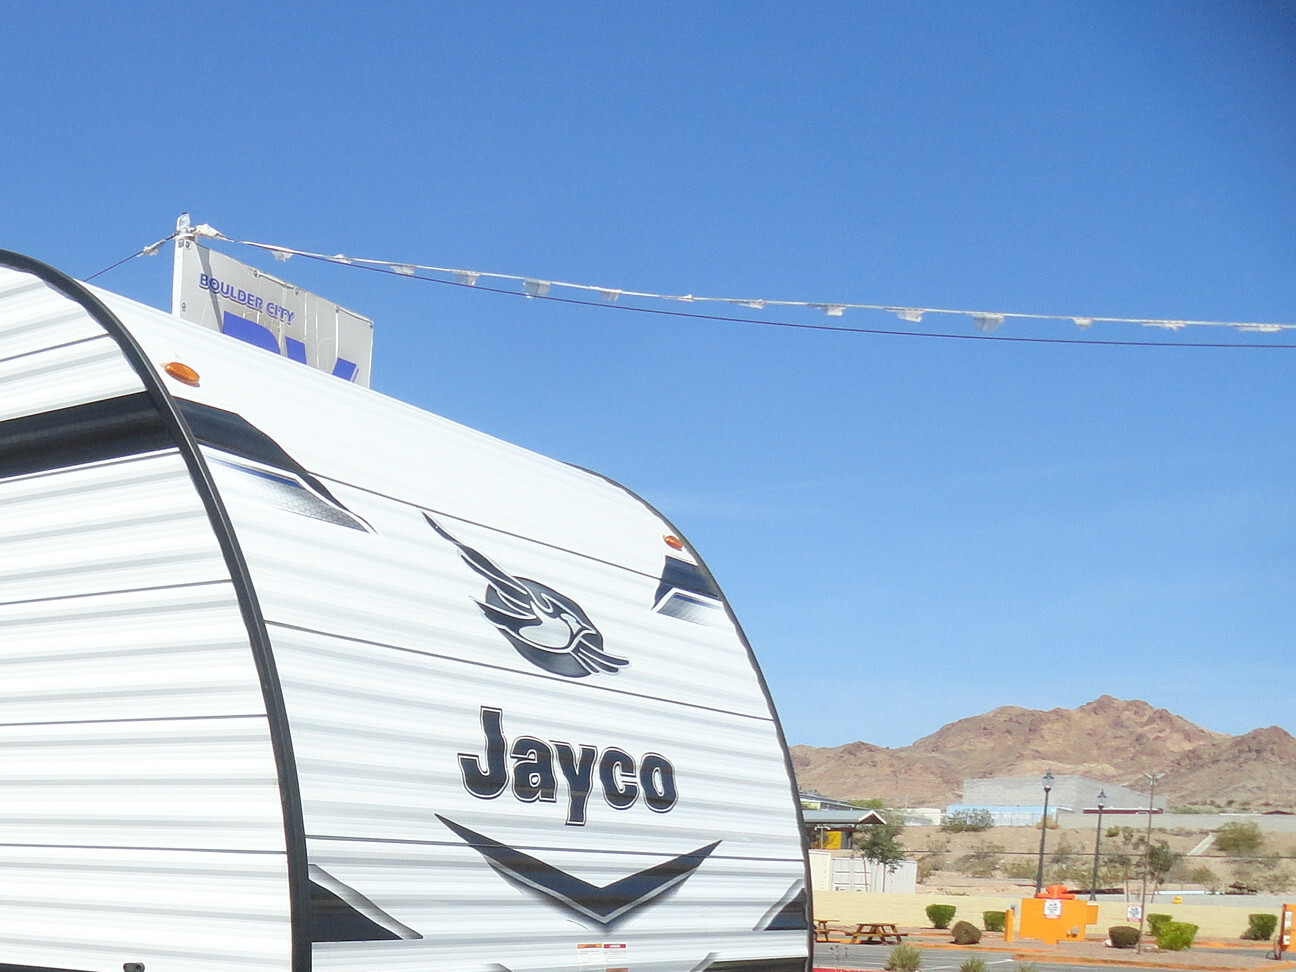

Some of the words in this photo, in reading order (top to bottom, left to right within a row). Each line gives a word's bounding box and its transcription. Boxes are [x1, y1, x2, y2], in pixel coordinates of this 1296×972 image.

[199, 273, 264, 312] BOULDER
[266, 302, 296, 325] CITY
[457, 705, 679, 826] Jayco
